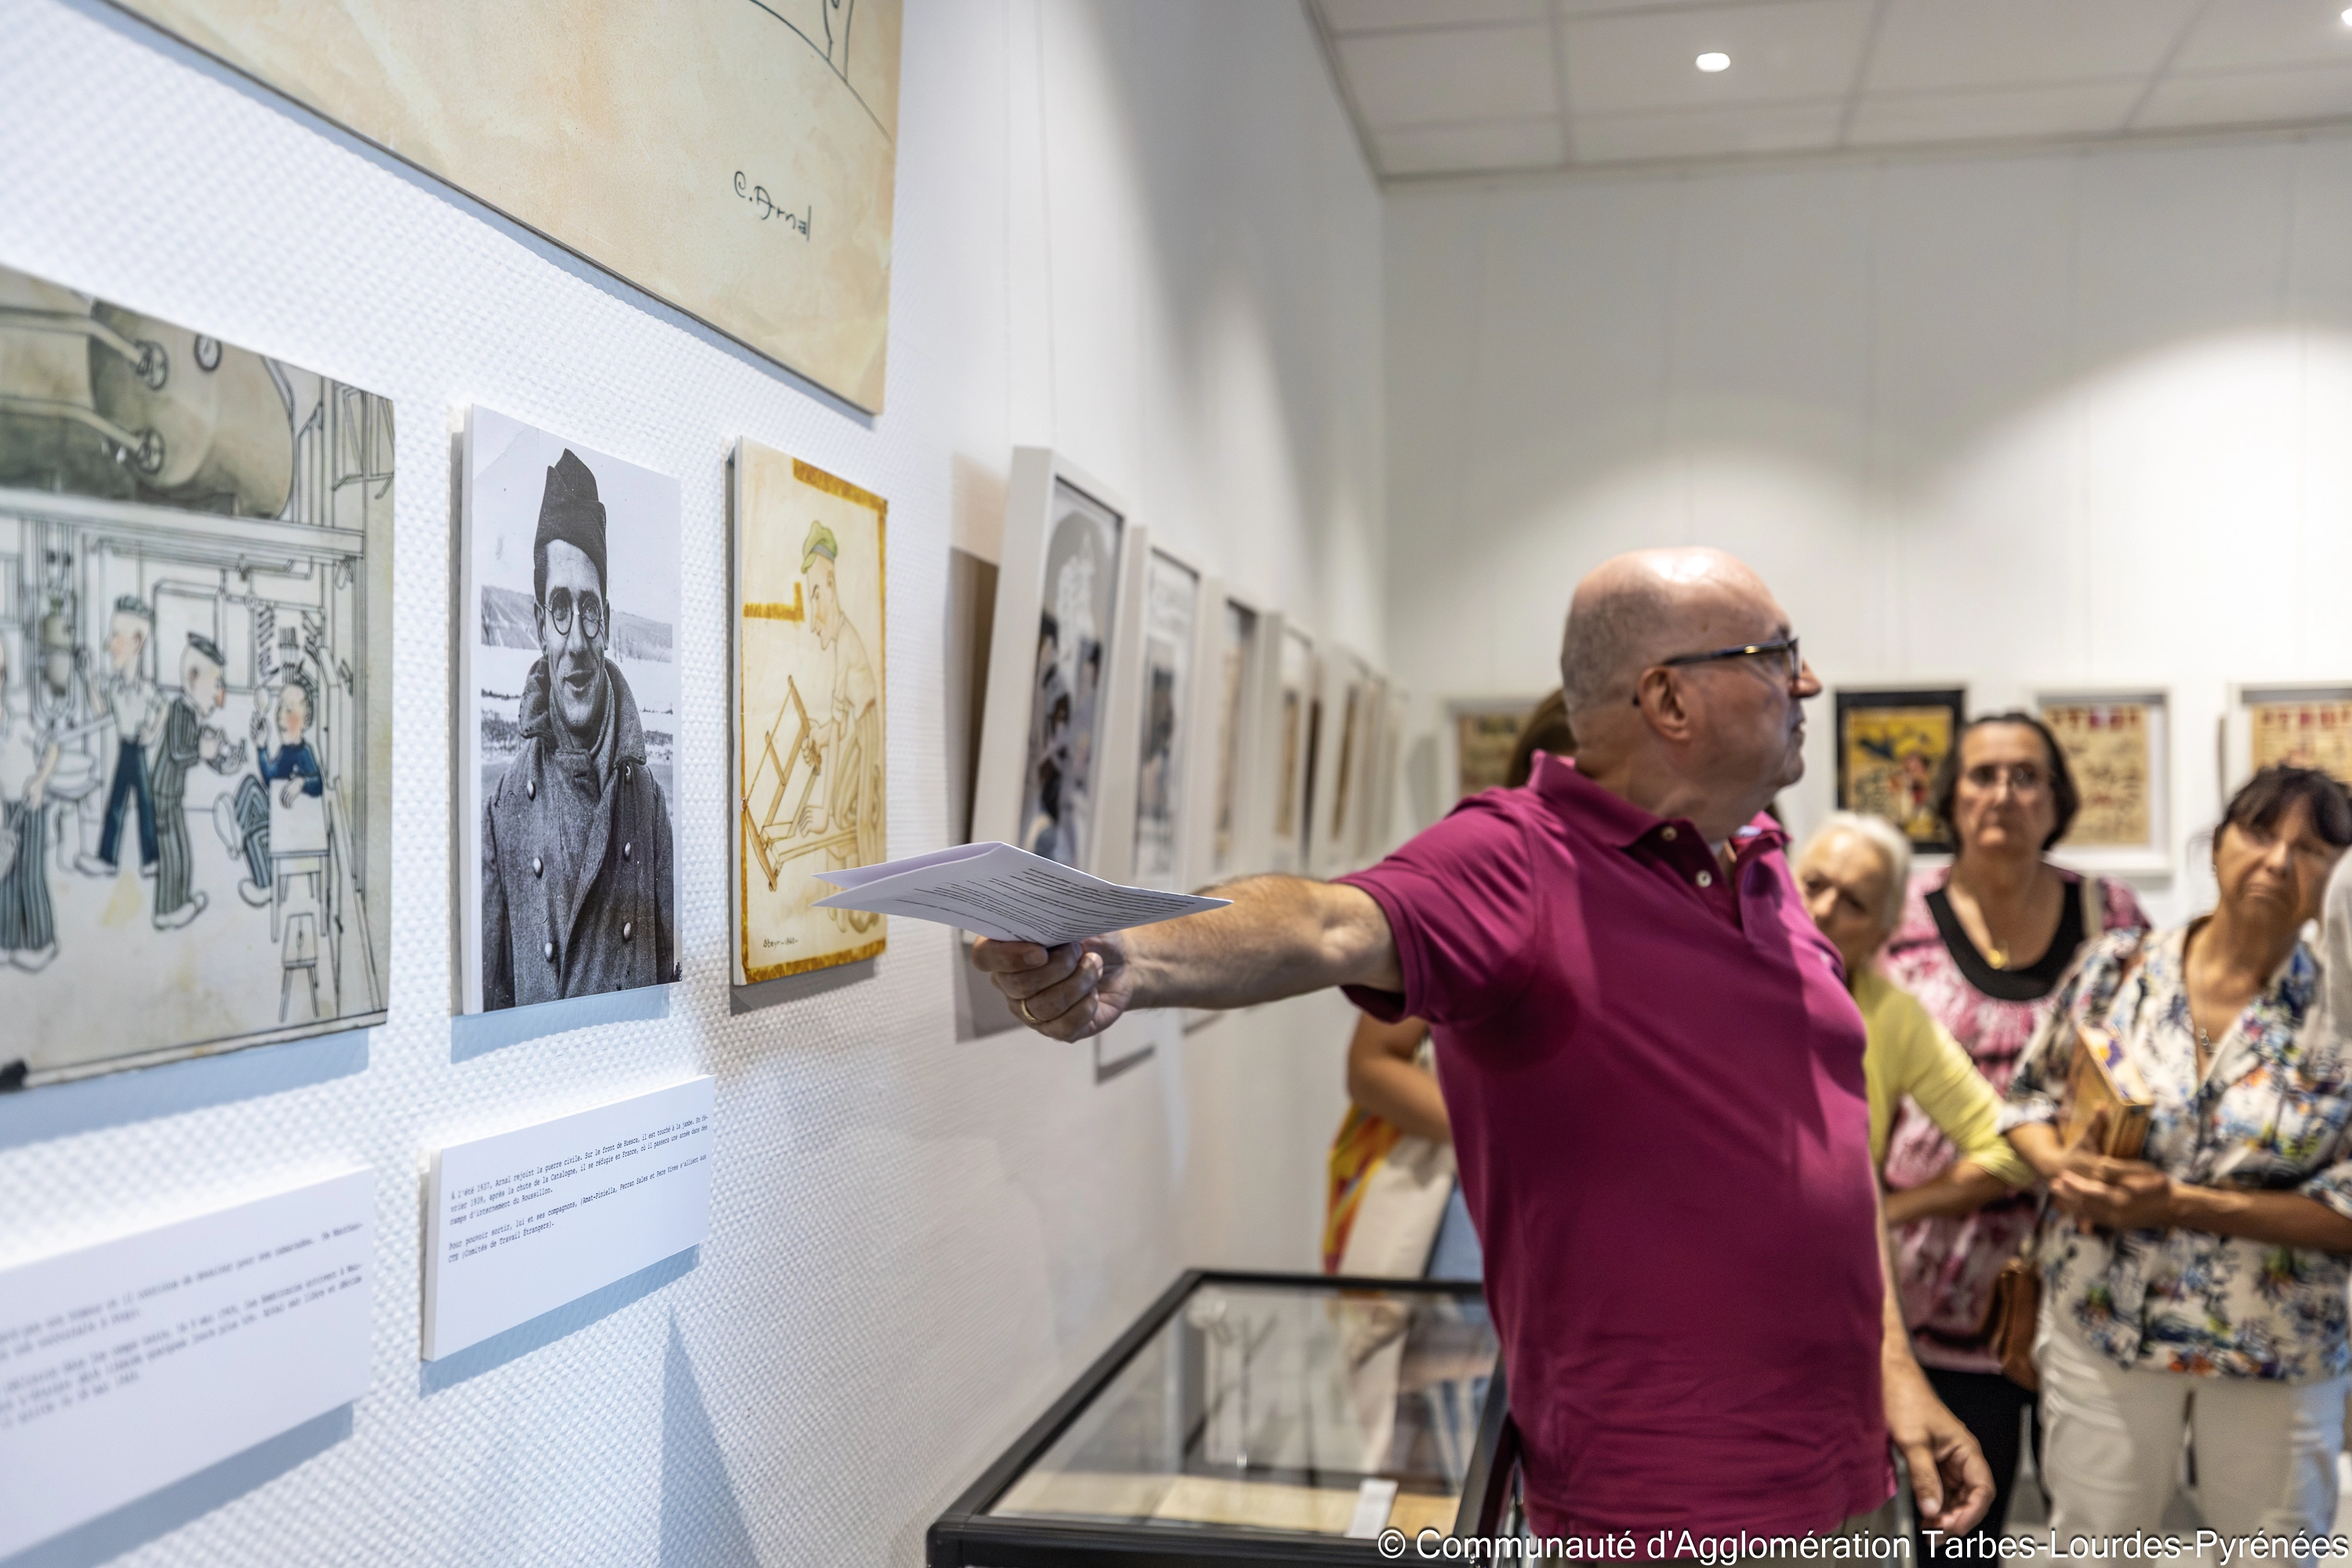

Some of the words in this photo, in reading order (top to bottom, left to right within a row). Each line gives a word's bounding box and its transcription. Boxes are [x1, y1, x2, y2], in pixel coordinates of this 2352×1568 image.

[489, 1190, 505, 1201] après
[517, 1182, 532, 1192] chute
[551, 1169, 577, 1181] Catalogne,
[596, 1156, 613, 1167] réfugie
[622, 1149, 638, 1157] France,
[654, 1138, 670, 1149] passera
[495, 1175, 510, 1186] Arnal
[514, 1170, 534, 1181] rejoint
[545, 1162, 561, 1173] guerre
[564, 1156, 582, 1165] civile.
[624, 1138, 640, 1146] Huesca,
[658, 1127, 671, 1135] touché
[466, 1232, 488, 1247] pouvoir
[492, 1225, 512, 1236] sortir,
[548, 1202, 577, 1216] compagnons,
[581, 1187, 617, 1205] (Amat-Piniella,
[620, 1181, 634, 1190] Ferran
[681, 1158, 698, 1168] s'allient
[470, 1200, 510, 1218] d'internement
[522, 1188, 553, 1202] Roussillon.
[499, 1232, 520, 1244] Travail
[524, 1221, 554, 1236] Étrangers).
